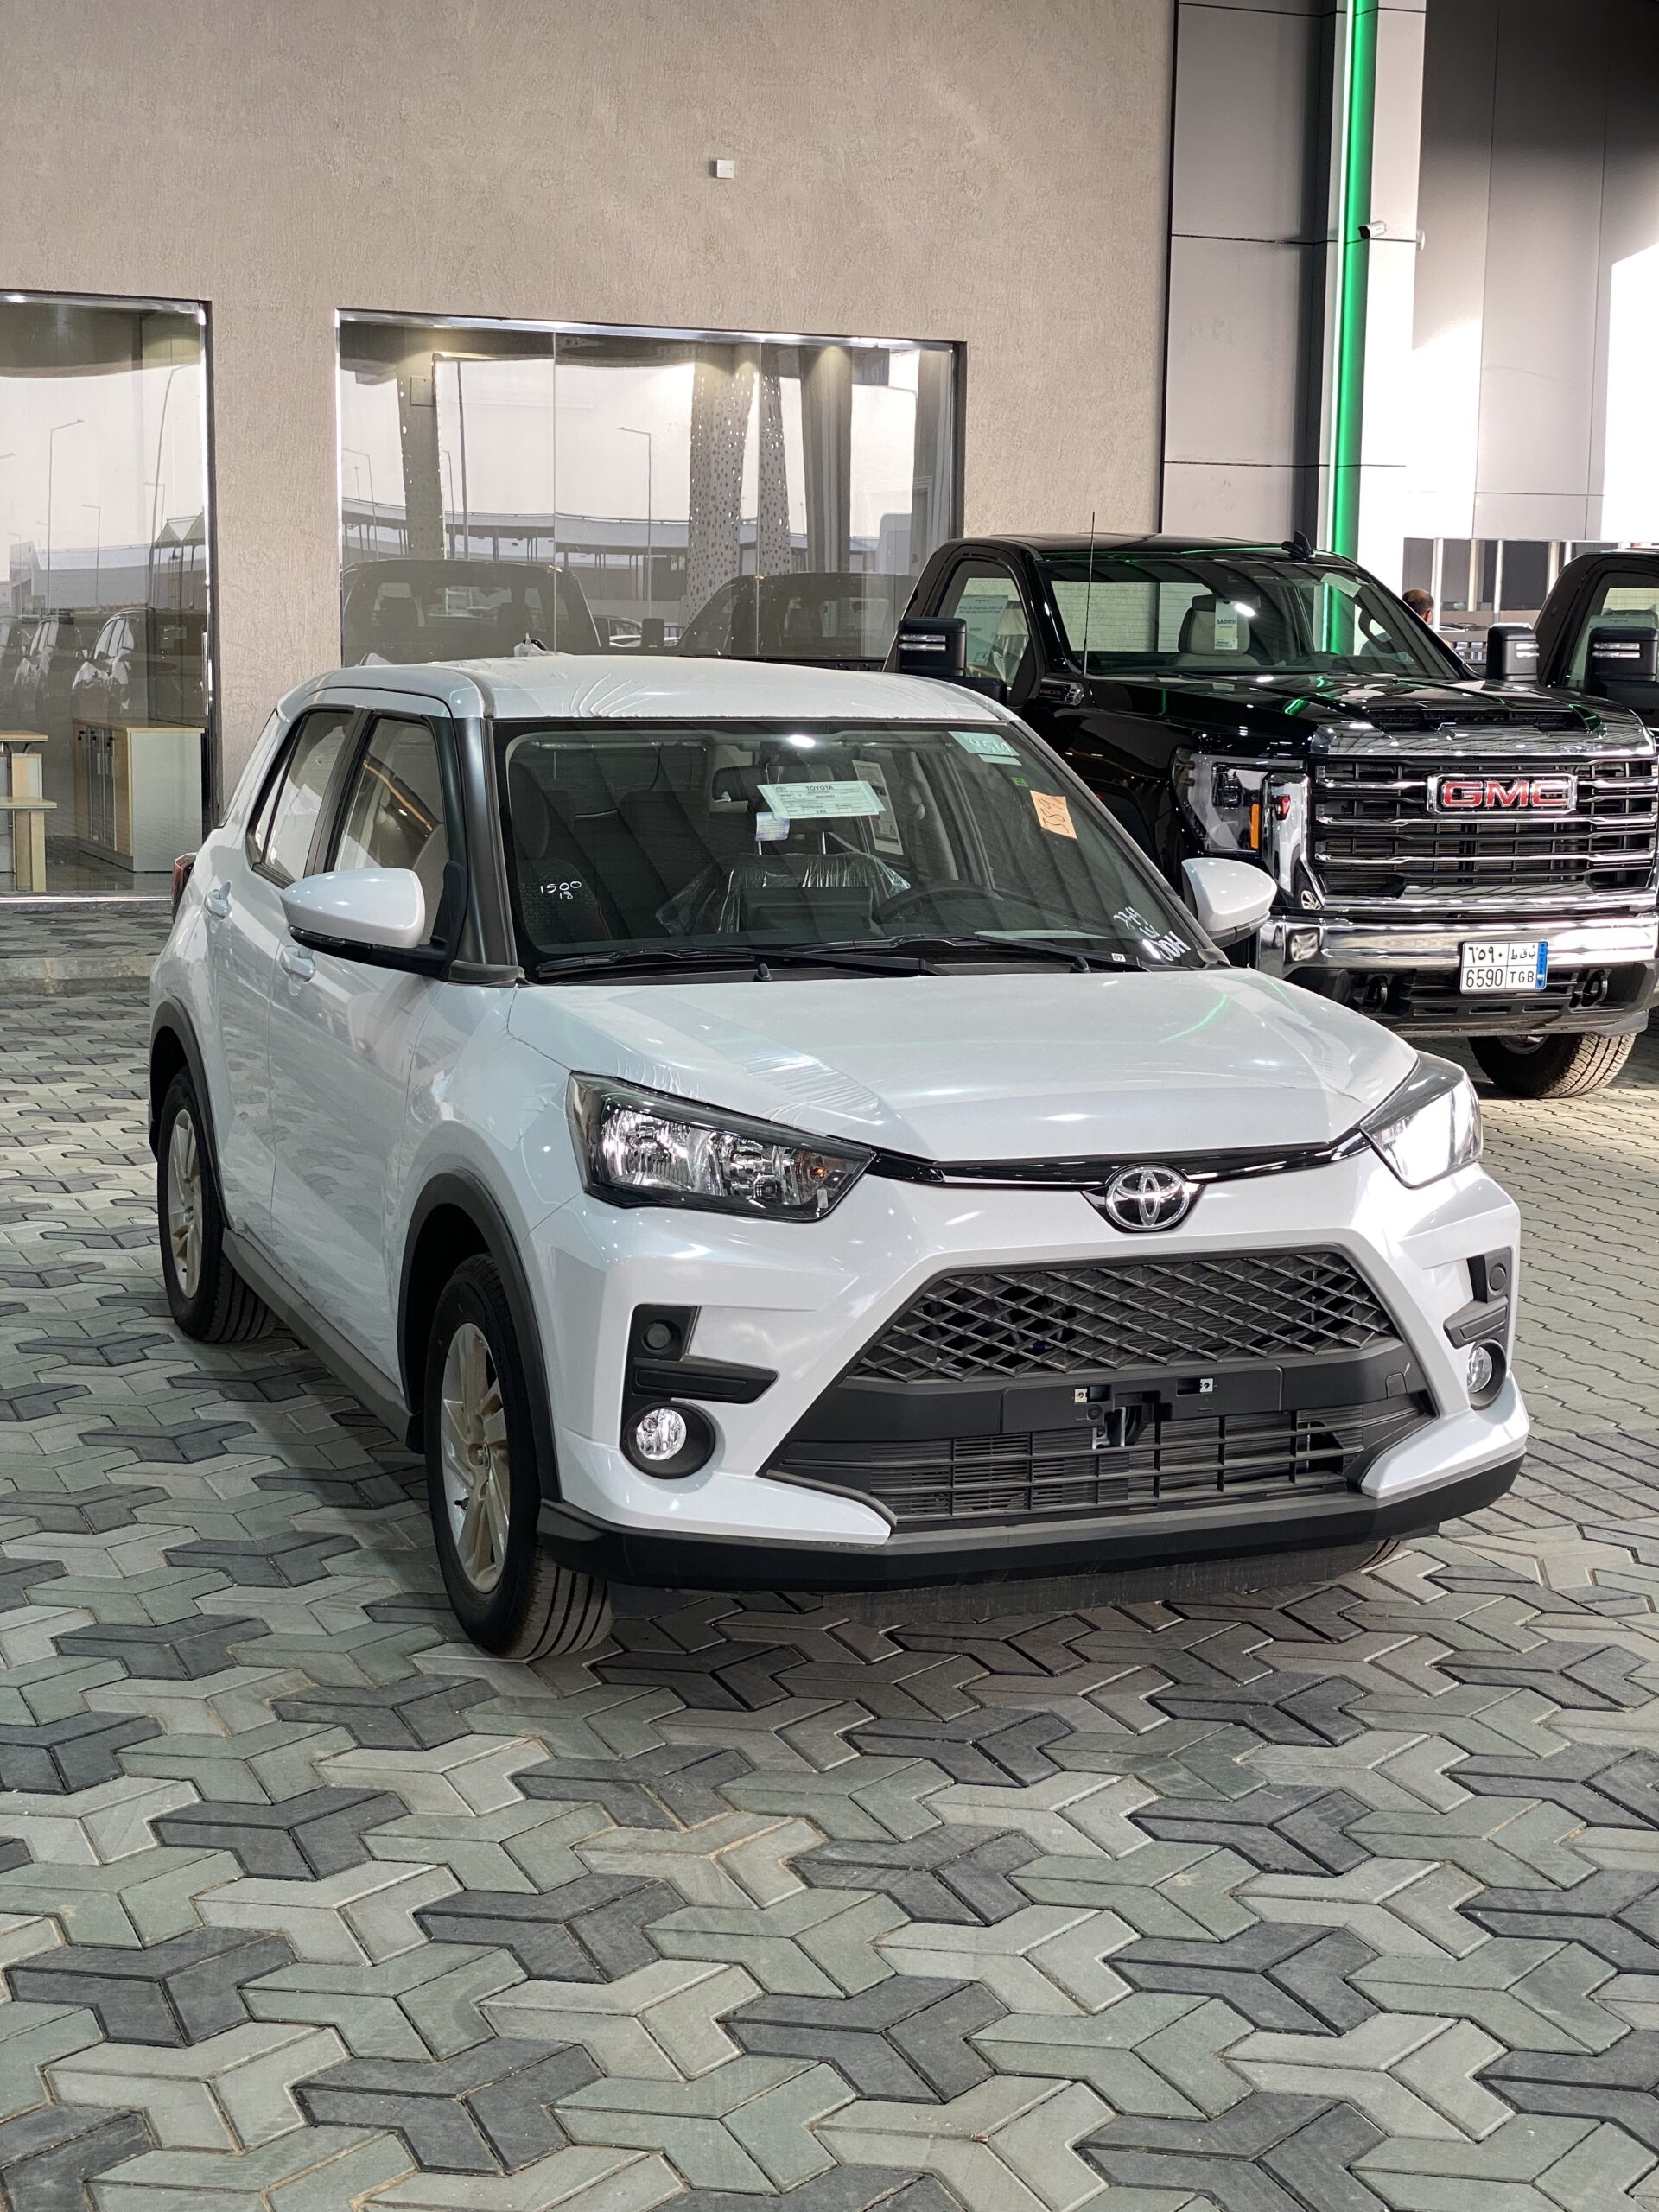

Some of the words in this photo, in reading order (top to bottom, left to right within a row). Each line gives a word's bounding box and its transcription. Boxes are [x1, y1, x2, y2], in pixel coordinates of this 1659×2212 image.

[1442, 780, 1568, 808] GMC
[540, 880, 582, 894] 1500
[559, 890, 574, 900] 18
[1465, 969, 1503, 988] 6590
[1510, 970, 1535, 983] TGB
